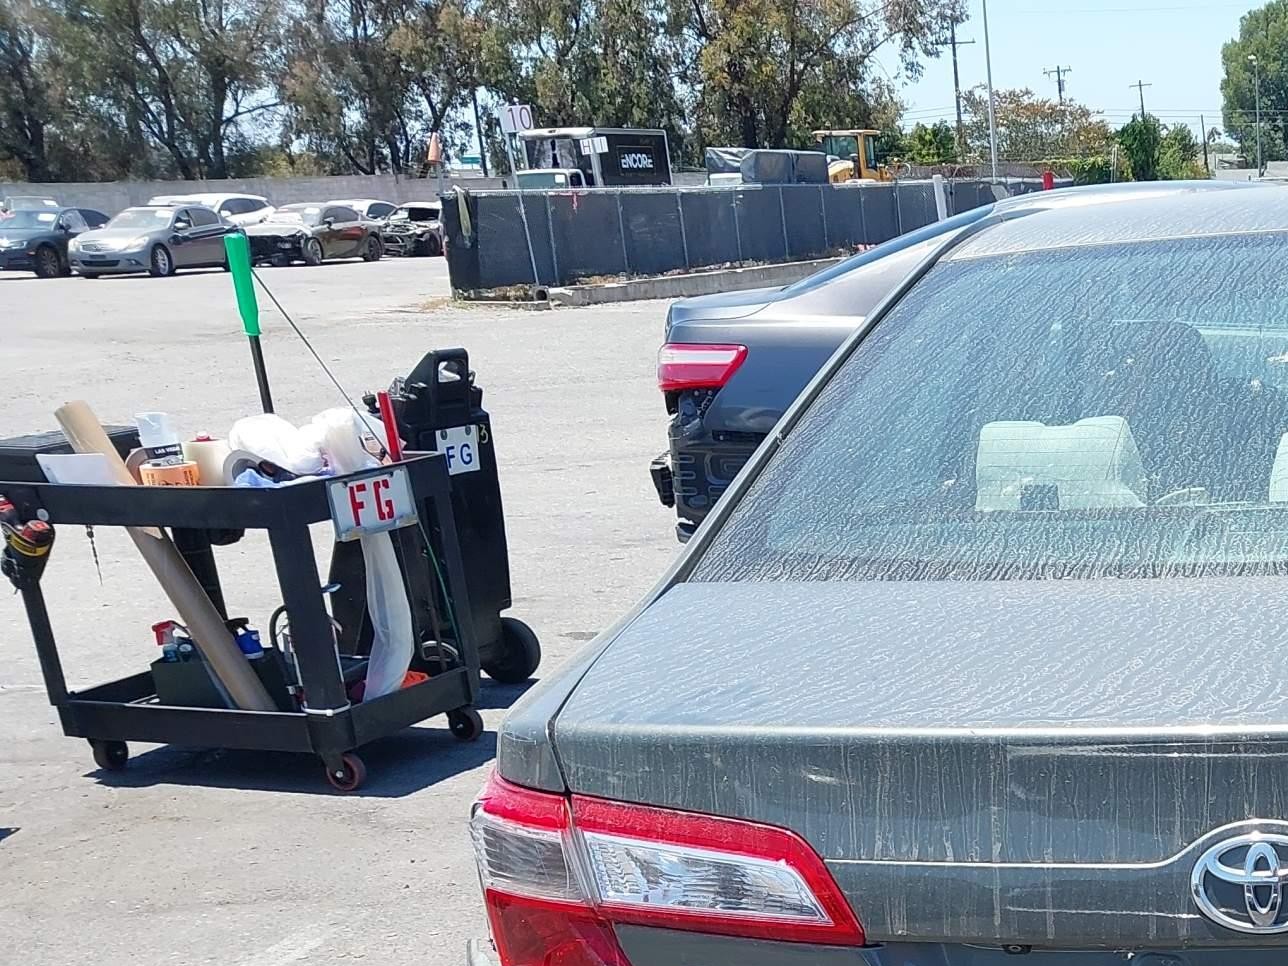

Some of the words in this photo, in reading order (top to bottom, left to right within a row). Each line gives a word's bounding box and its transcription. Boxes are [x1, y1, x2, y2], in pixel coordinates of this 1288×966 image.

[507, 106, 532, 131] 10
[581, 138, 592, 154] H
[620, 153, 654, 169] ENCORE
[446, 443, 473, 469] FG
[348, 478, 396, 527] FG
